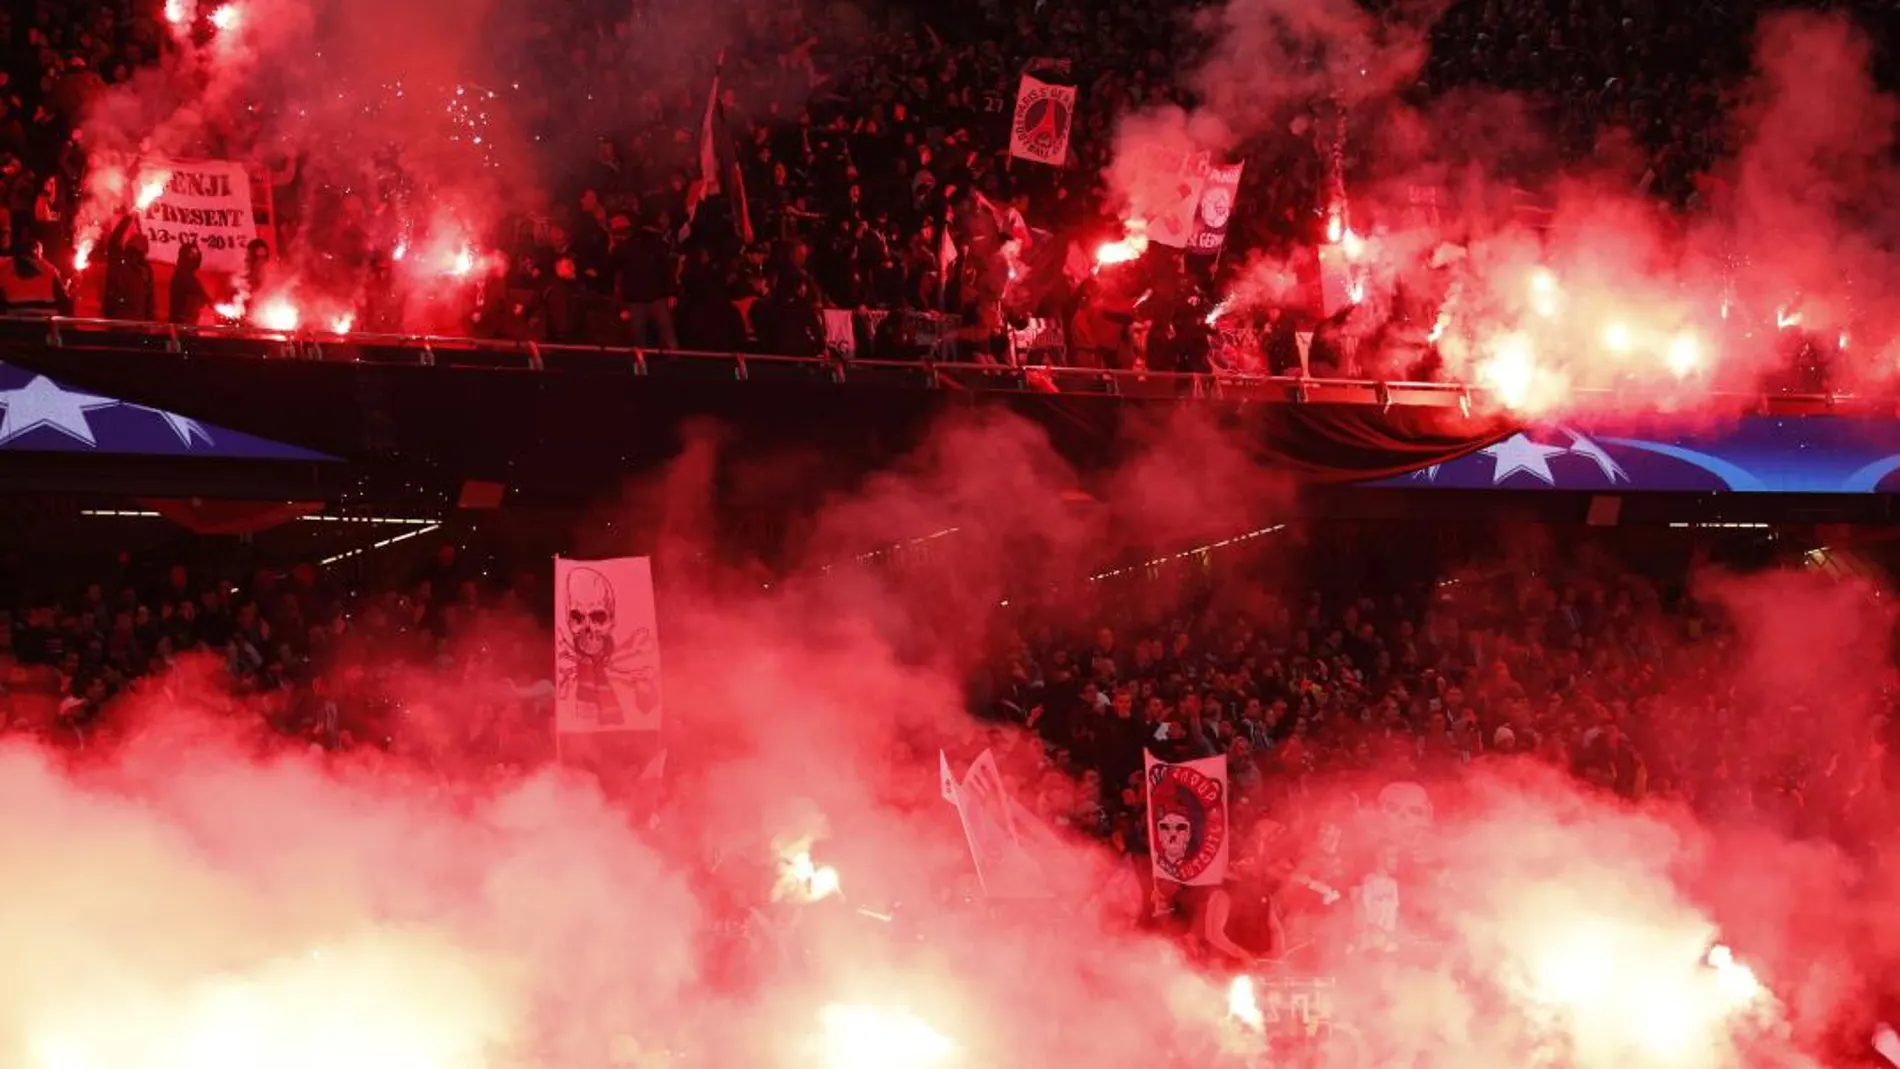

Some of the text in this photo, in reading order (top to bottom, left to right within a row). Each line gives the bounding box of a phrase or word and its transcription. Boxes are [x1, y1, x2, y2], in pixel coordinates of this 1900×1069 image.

[984, 97, 1004, 113] 27
[164, 171, 232, 197] ENJI
[144, 201, 245, 227] PRESENT
